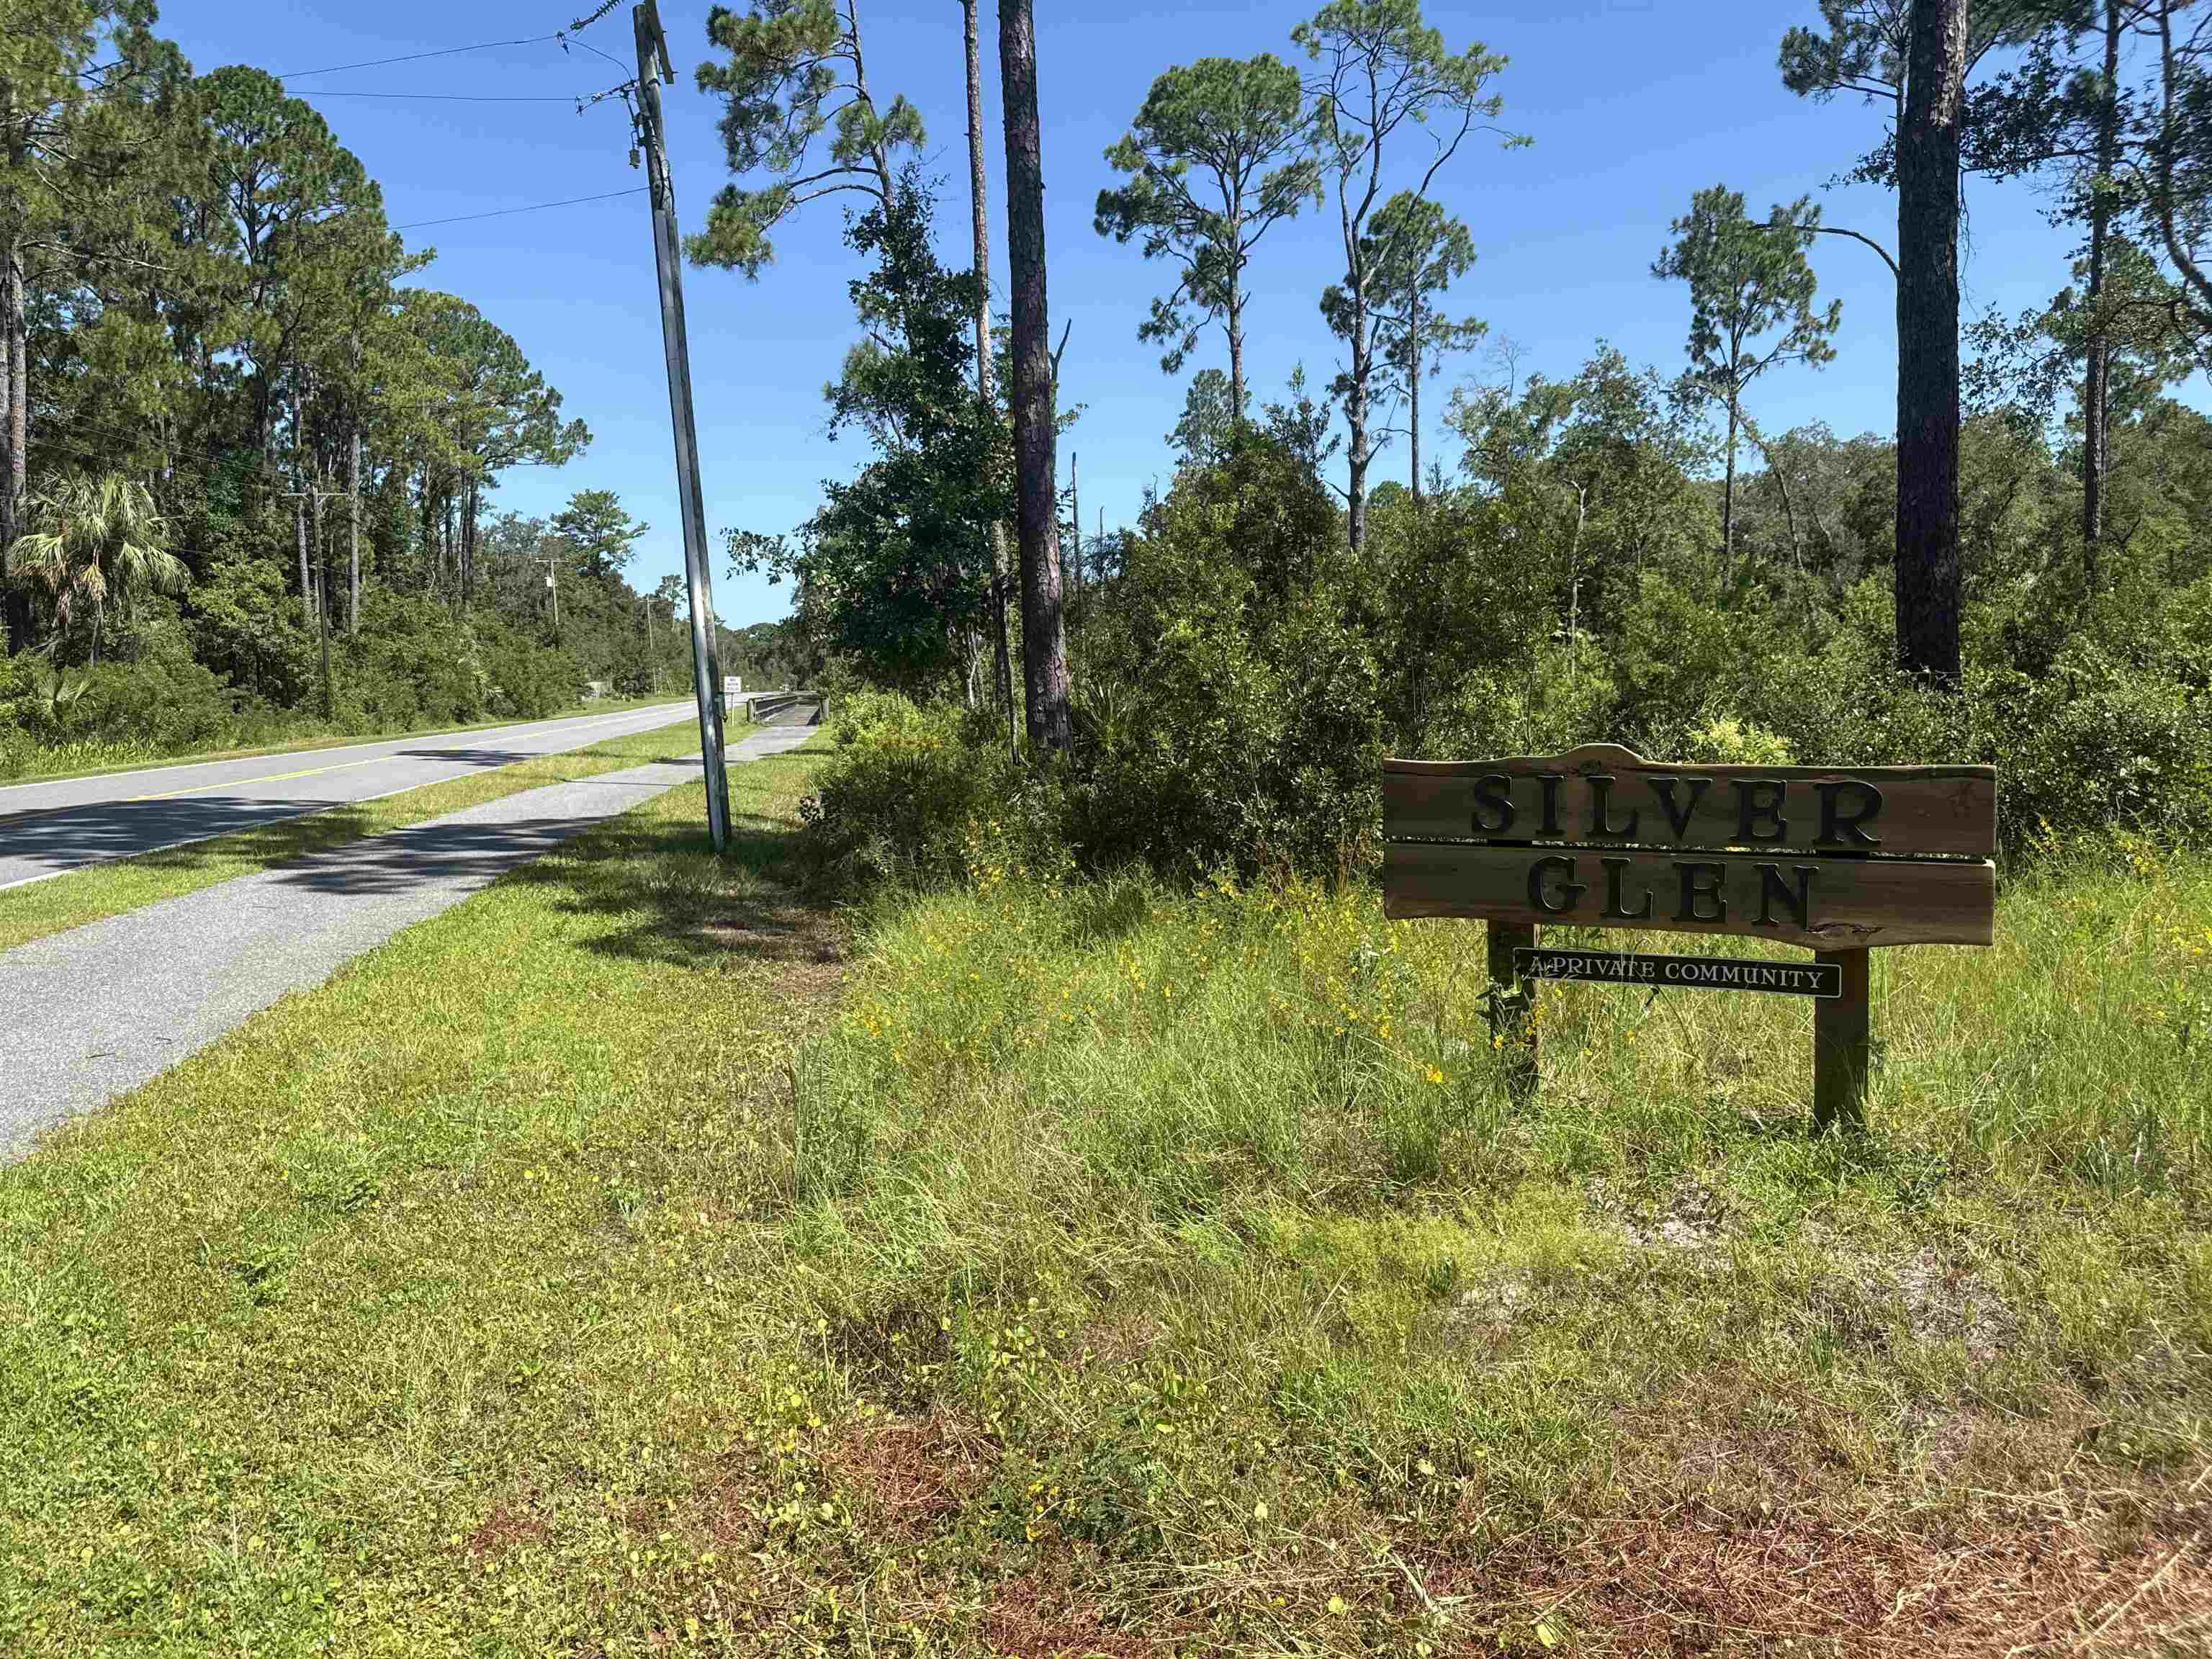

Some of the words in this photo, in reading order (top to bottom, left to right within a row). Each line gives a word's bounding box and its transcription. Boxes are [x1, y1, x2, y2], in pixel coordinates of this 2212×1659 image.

[1471, 773, 1884, 845] SILVER
[1528, 855, 1820, 930] GLEN
[1528, 955, 1545, 972] A
[1552, 956, 1655, 978] PRIVATE
[1664, 962, 1824, 989] COMMUNITY
